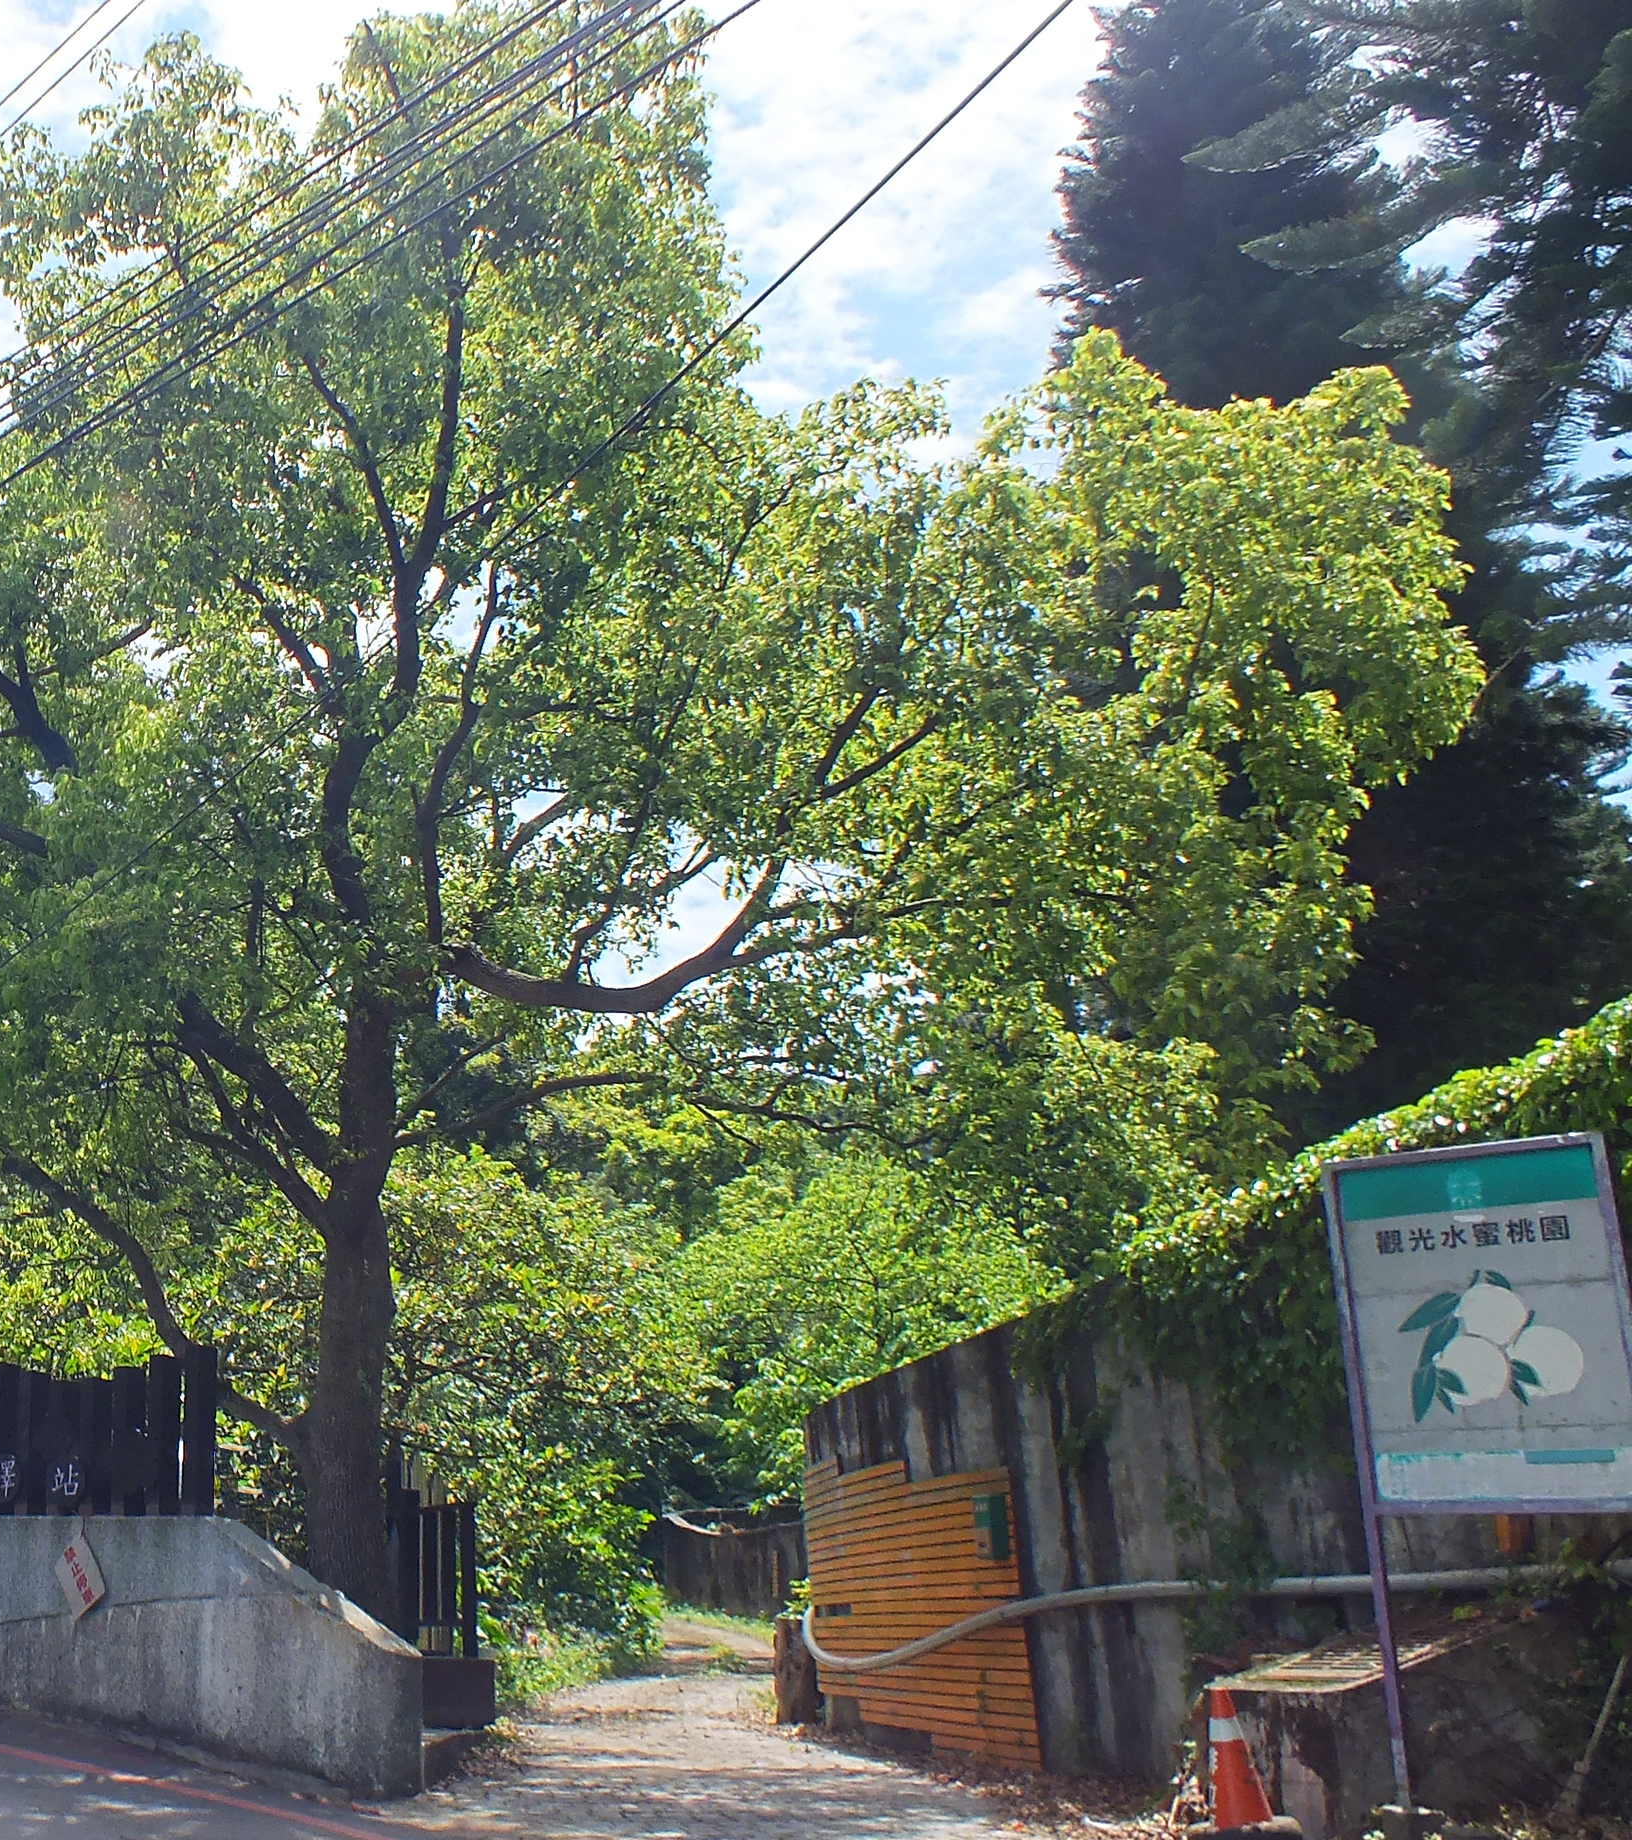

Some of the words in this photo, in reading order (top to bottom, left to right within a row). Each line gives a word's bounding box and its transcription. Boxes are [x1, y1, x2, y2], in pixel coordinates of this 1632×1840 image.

[1376, 1215, 1570, 1254] 觀光水蜜桃園
